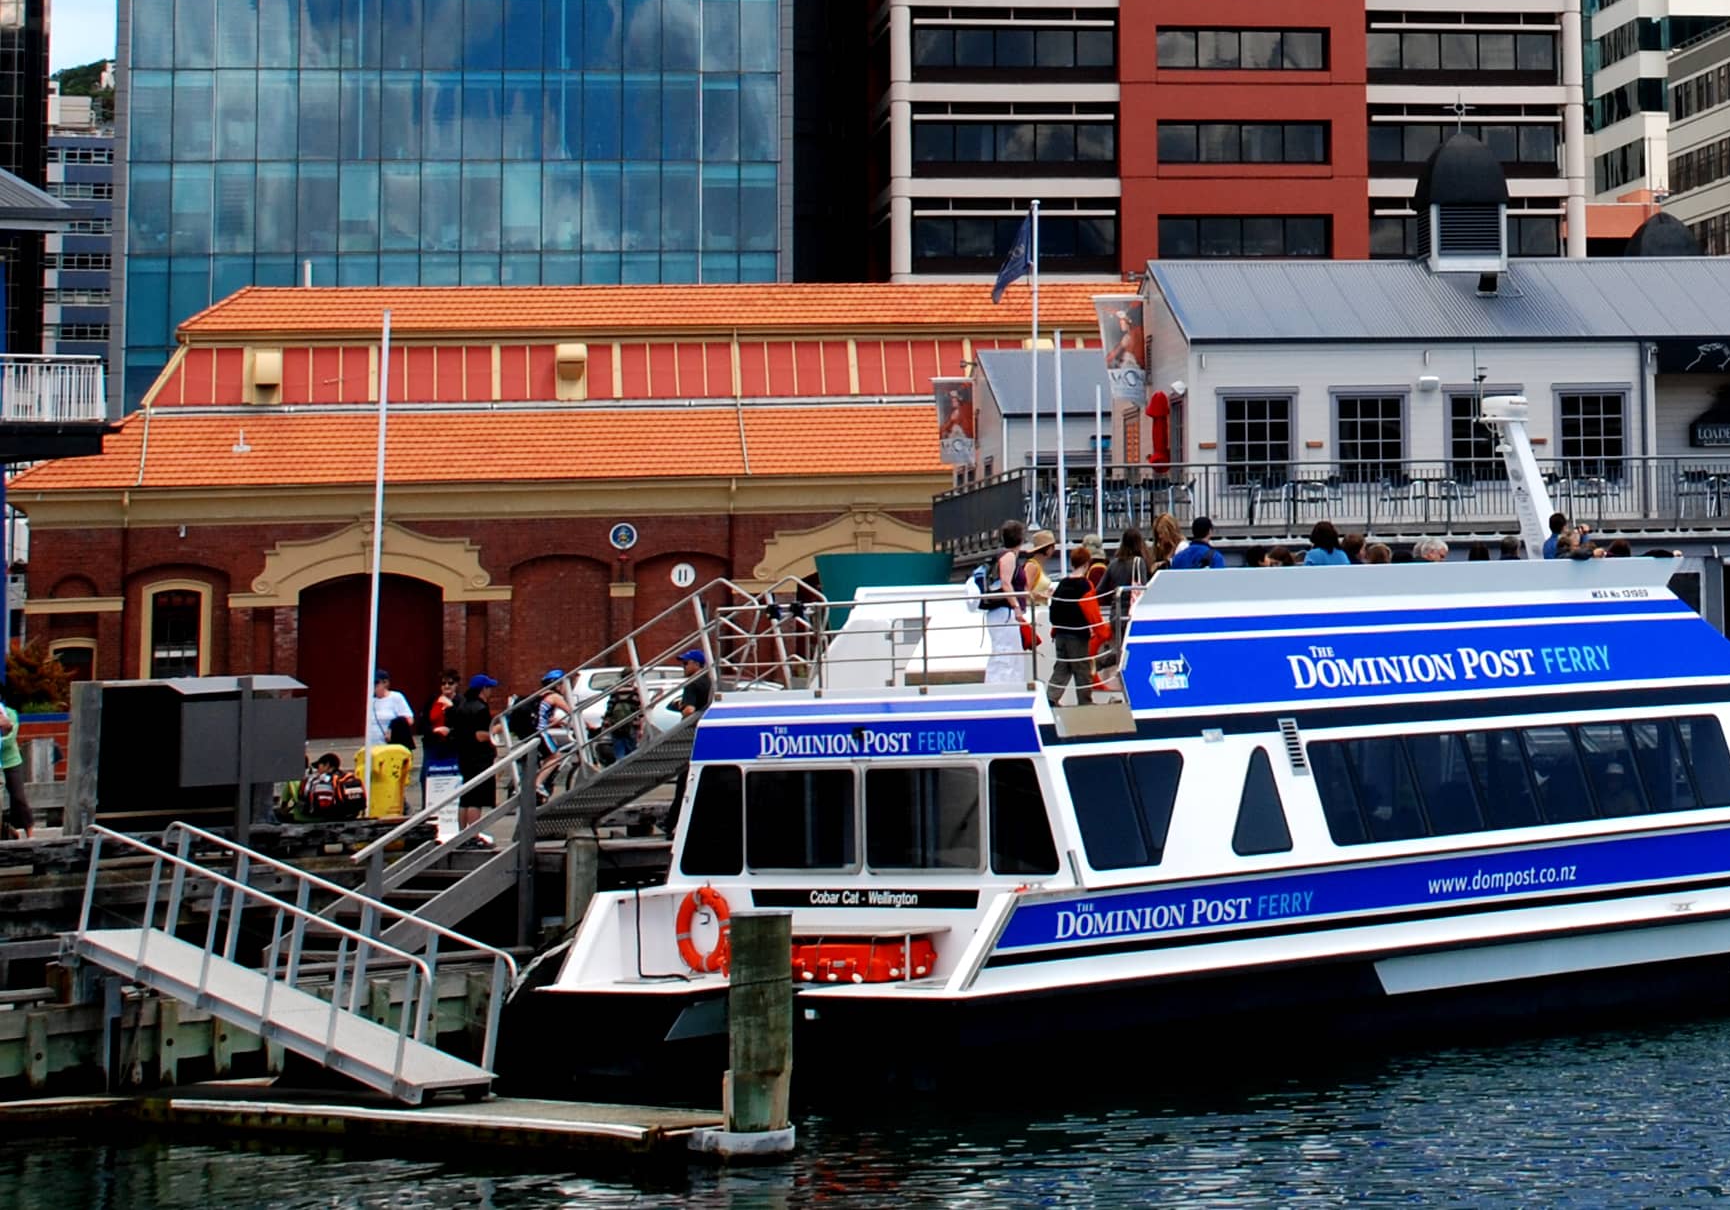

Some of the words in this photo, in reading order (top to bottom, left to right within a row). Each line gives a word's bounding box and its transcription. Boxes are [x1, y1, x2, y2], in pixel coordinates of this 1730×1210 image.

[1308, 645, 1335, 659] THE
[1151, 660, 1185, 675] EAST
[1286, 652, 1457, 690] DOMINION
[1457, 647, 1536, 680] POST
[1541, 644, 1611, 675] FERRY
[1154, 676, 1188, 690] WEST
[759, 730, 860, 757] DOMINION
[861, 729, 912, 754] POST
[918, 730, 966, 751] FERRY
[1428, 865, 1577, 894] www.dompost.co.nz
[809, 890, 840, 905] Cobar
[842, 890, 860, 905] Cat
[868, 890, 919, 908] Wellington
[1076, 902, 1095, 914] THE
[1055, 903, 1187, 939] DOMINION
[1191, 897, 1252, 925] POST
[1257, 890, 1314, 918] FERRY
